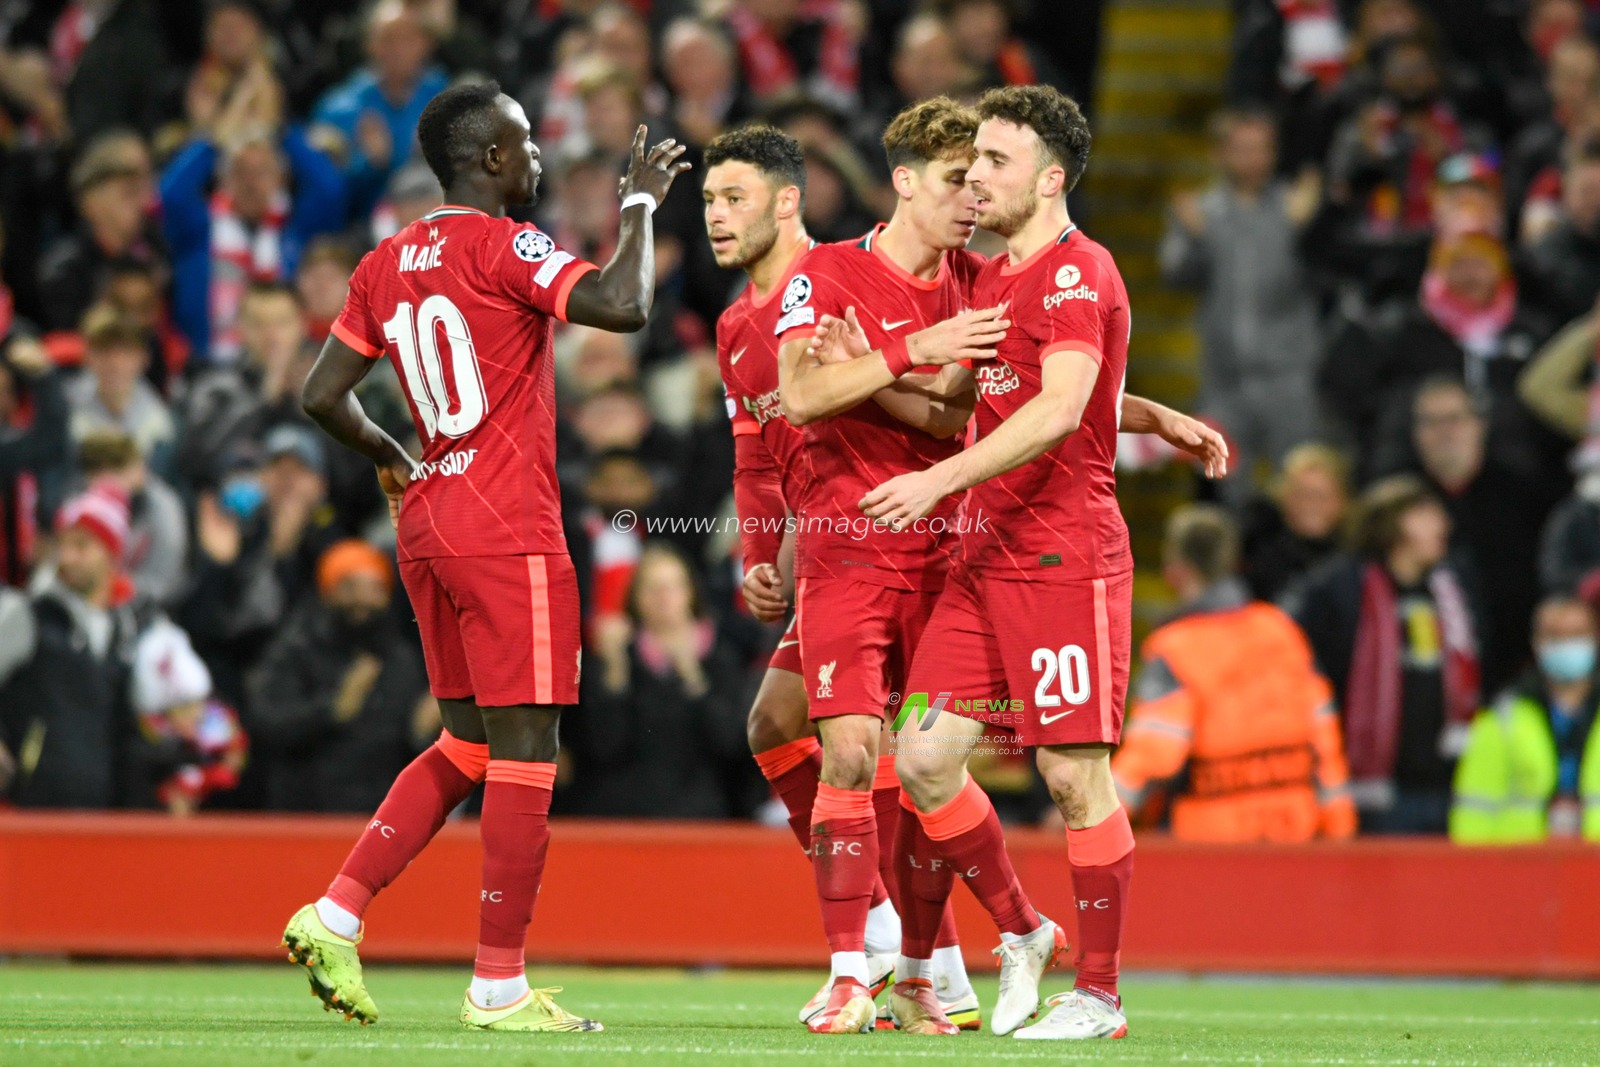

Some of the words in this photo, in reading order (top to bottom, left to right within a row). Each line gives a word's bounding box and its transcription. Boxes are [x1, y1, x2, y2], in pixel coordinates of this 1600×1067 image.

[1043, 284, 1098, 311] Expedia
[383, 294, 489, 442] 10
[1031, 644, 1091, 708] 20
